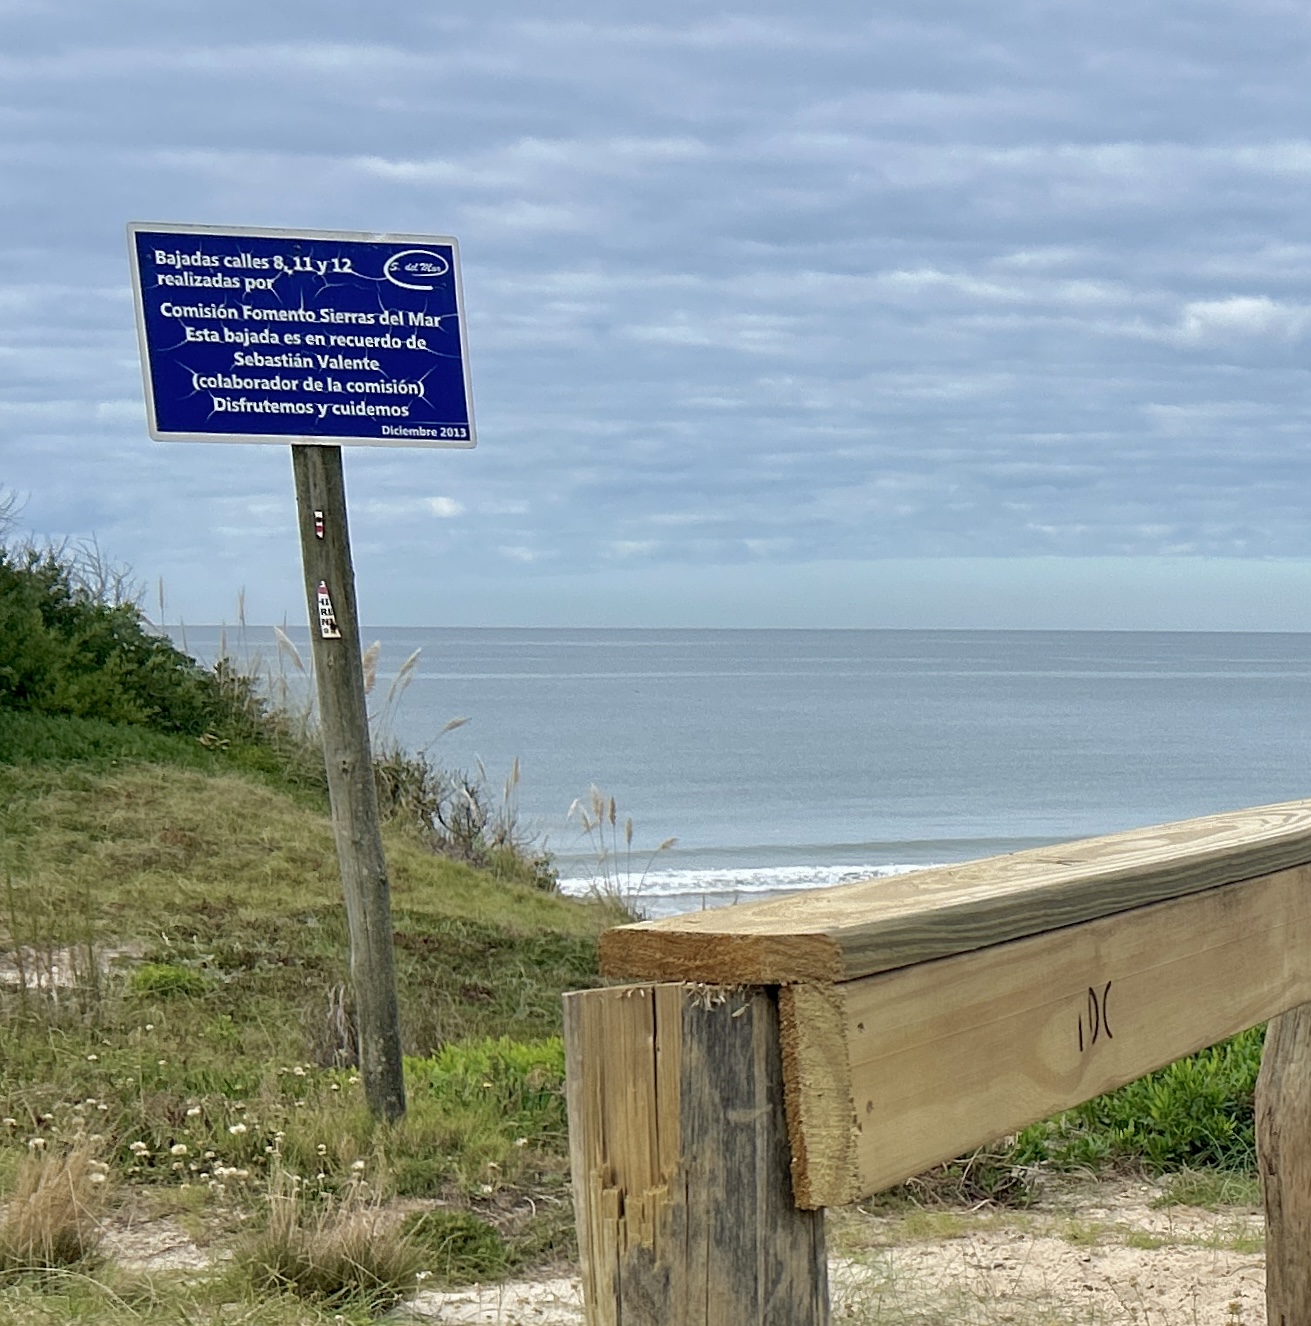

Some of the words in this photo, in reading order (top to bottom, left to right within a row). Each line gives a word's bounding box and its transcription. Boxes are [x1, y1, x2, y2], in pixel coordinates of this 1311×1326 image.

[154, 250, 219, 269] Bajadas
[224, 252, 269, 269] calles
[273, 255, 289, 272] 8,
[293, 257, 313, 271] 11
[317, 259, 328, 275] y
[331, 257, 351, 272] 12
[157, 271, 240, 288] realizadas
[245, 276, 274, 292] por
[160, 302, 238, 319] Comisión
[242, 305, 316, 322] Fomento
[320, 308, 375, 325] Sierras
[380, 310, 404, 325] del
[408, 311, 441, 327] Mar
[185, 327, 219, 342] Esta
[224, 327, 279, 347] bajada
[284, 333, 301, 345] es
[305, 333, 325, 346] en
[330, 333, 401, 348] recuerdo
[406, 334, 426, 349] de
[234, 351, 313, 368] Sebastián
[317, 354, 379, 370] Valente
[192, 373, 298, 391] (colaborador
[303, 376, 323, 391] de
[327, 377, 342, 392] la
[346, 379, 424, 397] comisión)
[213, 397, 313, 414] Disfrutemos
[317, 402, 327, 418] y
[331, 401, 409, 416] cuidemos
[381, 425, 437, 437] Diciembre
[440, 426, 467, 438] 2013
